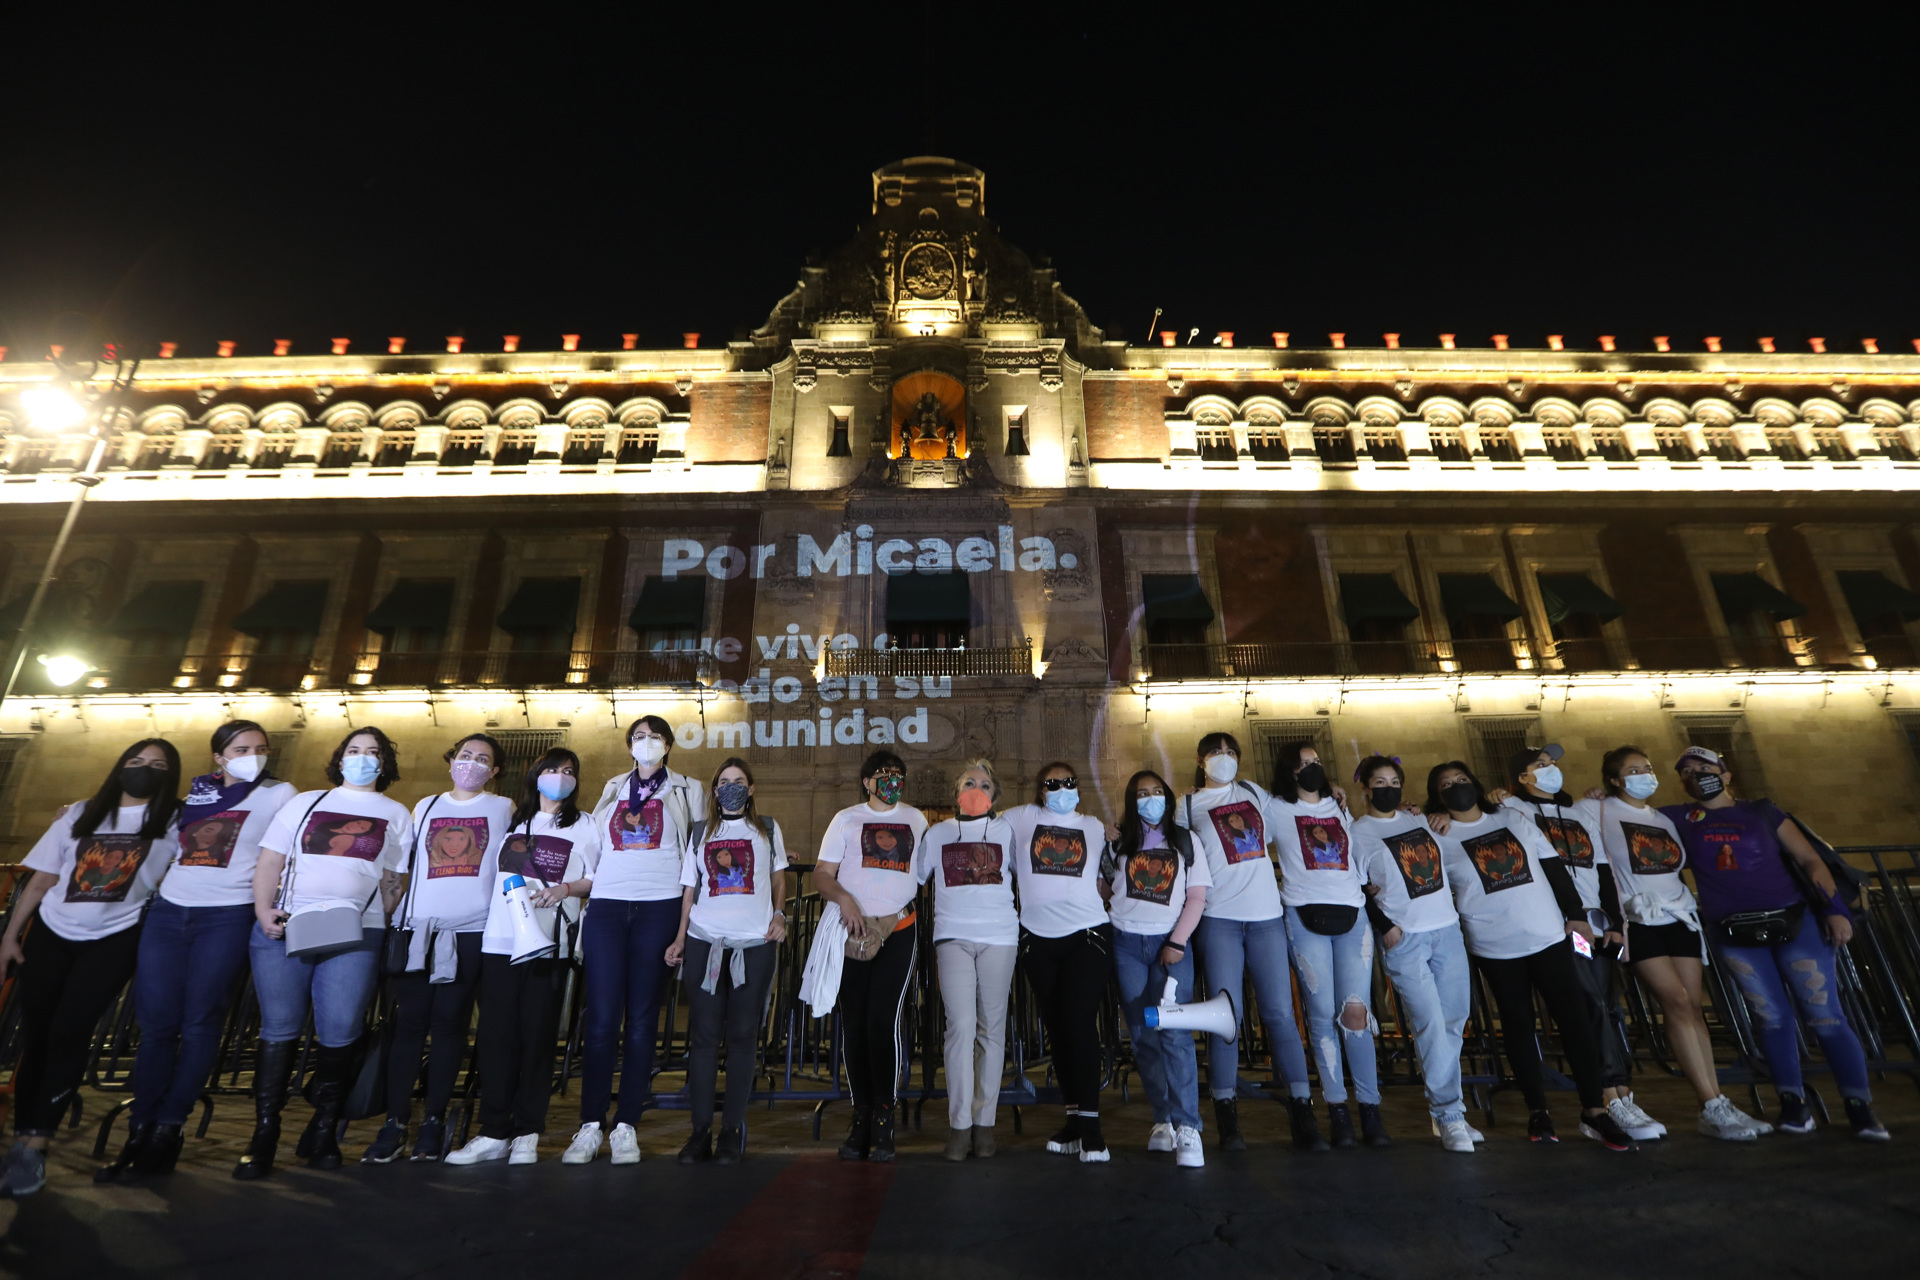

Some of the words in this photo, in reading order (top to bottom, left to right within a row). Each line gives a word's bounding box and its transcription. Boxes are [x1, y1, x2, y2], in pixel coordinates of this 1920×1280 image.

[661, 538, 775, 582] Por
[797, 524, 1078, 578] Micaela.
[756, 623, 859, 661] vive
[817, 675, 880, 702] en
[894, 675, 952, 700] su
[672, 706, 928, 750] omunidad
[1215, 802, 1250, 816] JUSTICIA
[432, 818, 485, 828] JUSTICIA
[1301, 817, 1336, 826] JUSTICIA
[1703, 833, 1740, 842] MATA
[709, 840, 746, 850] JUSTICIA
[870, 858, 905, 871] GLORIA
[435, 866, 456, 877] ELENA
